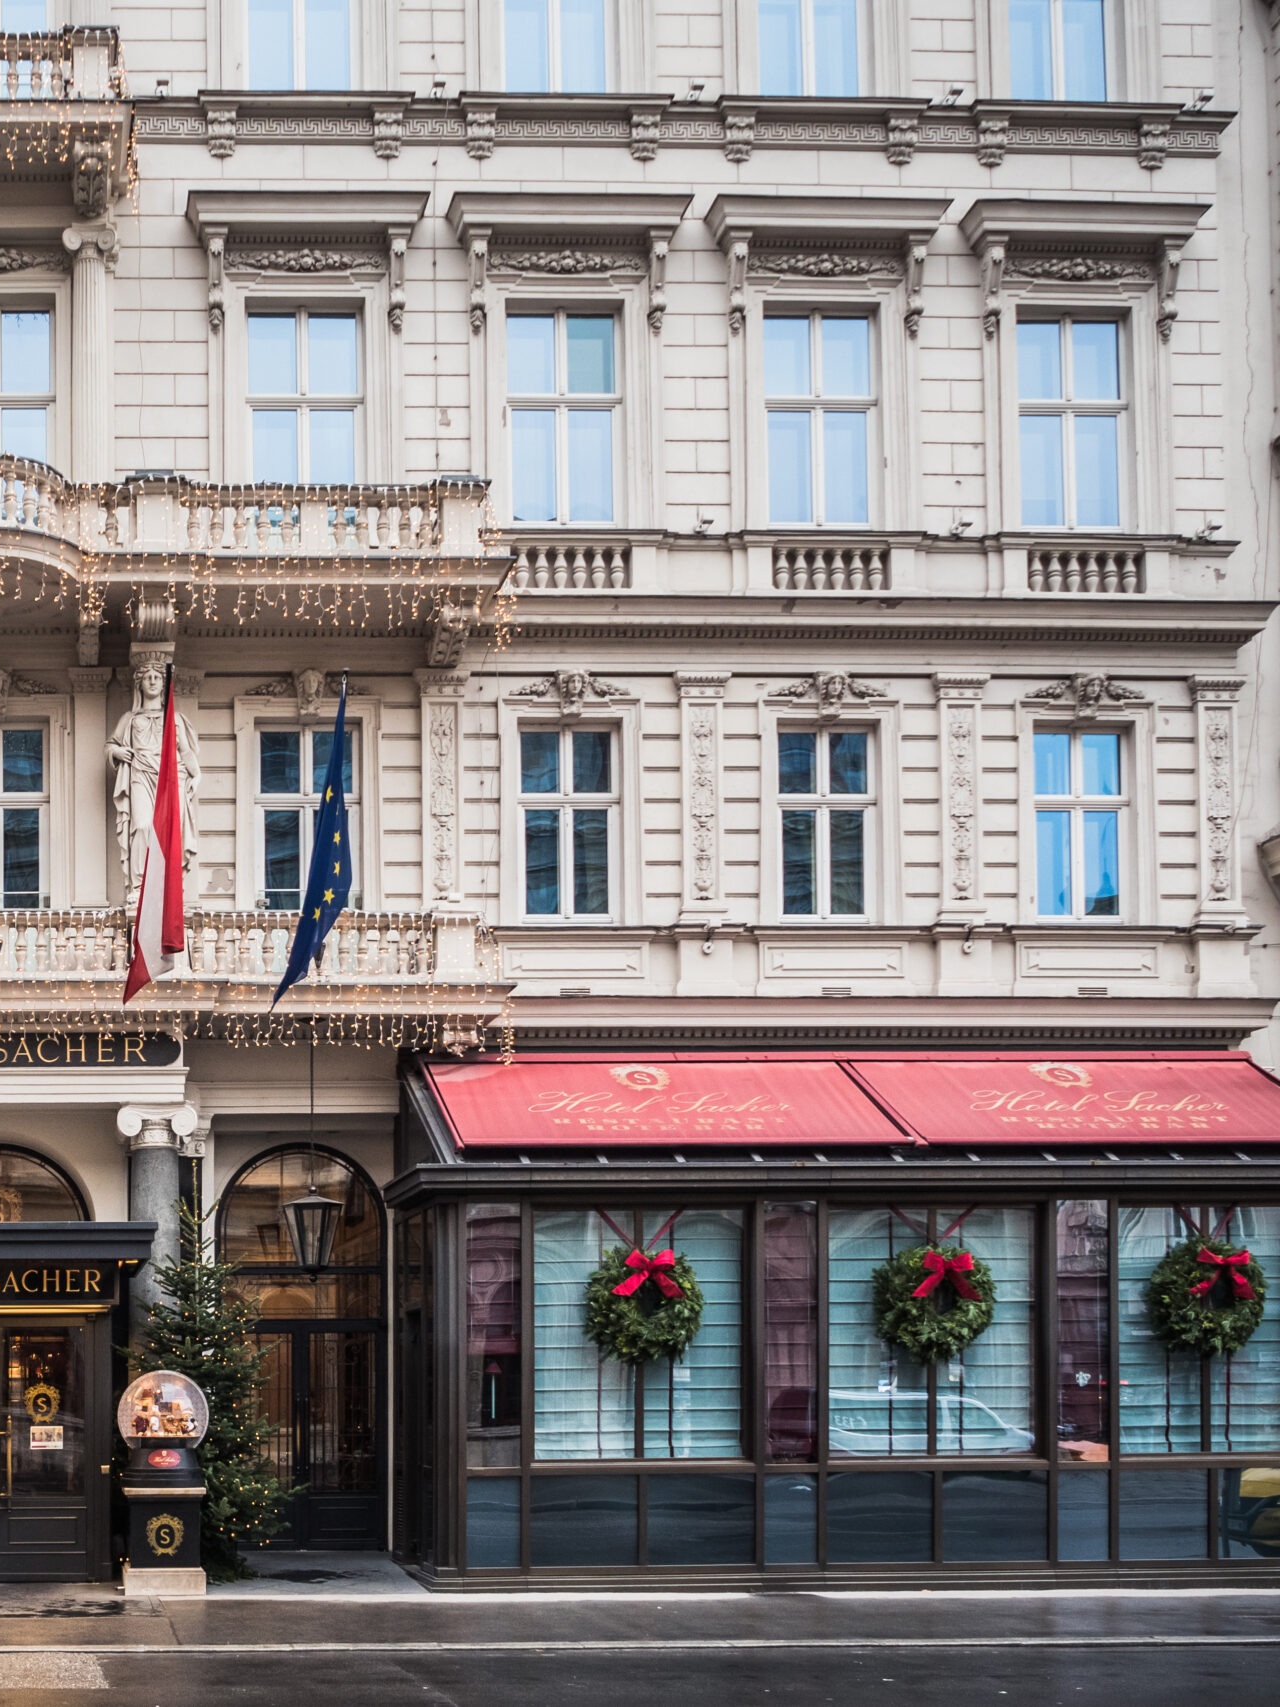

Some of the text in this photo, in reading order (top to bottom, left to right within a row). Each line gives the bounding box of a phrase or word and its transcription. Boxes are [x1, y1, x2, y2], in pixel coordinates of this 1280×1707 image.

[633, 1073, 652, 1084] S
[528, 1091, 794, 1113] Hotel Sacher
[970, 1090, 1231, 1112] Hotel Sacher
[553, 1117, 789, 1125] RESTAURANT
[37, 1397, 47, 1413] S
[160, 1528, 170, 1544] S
